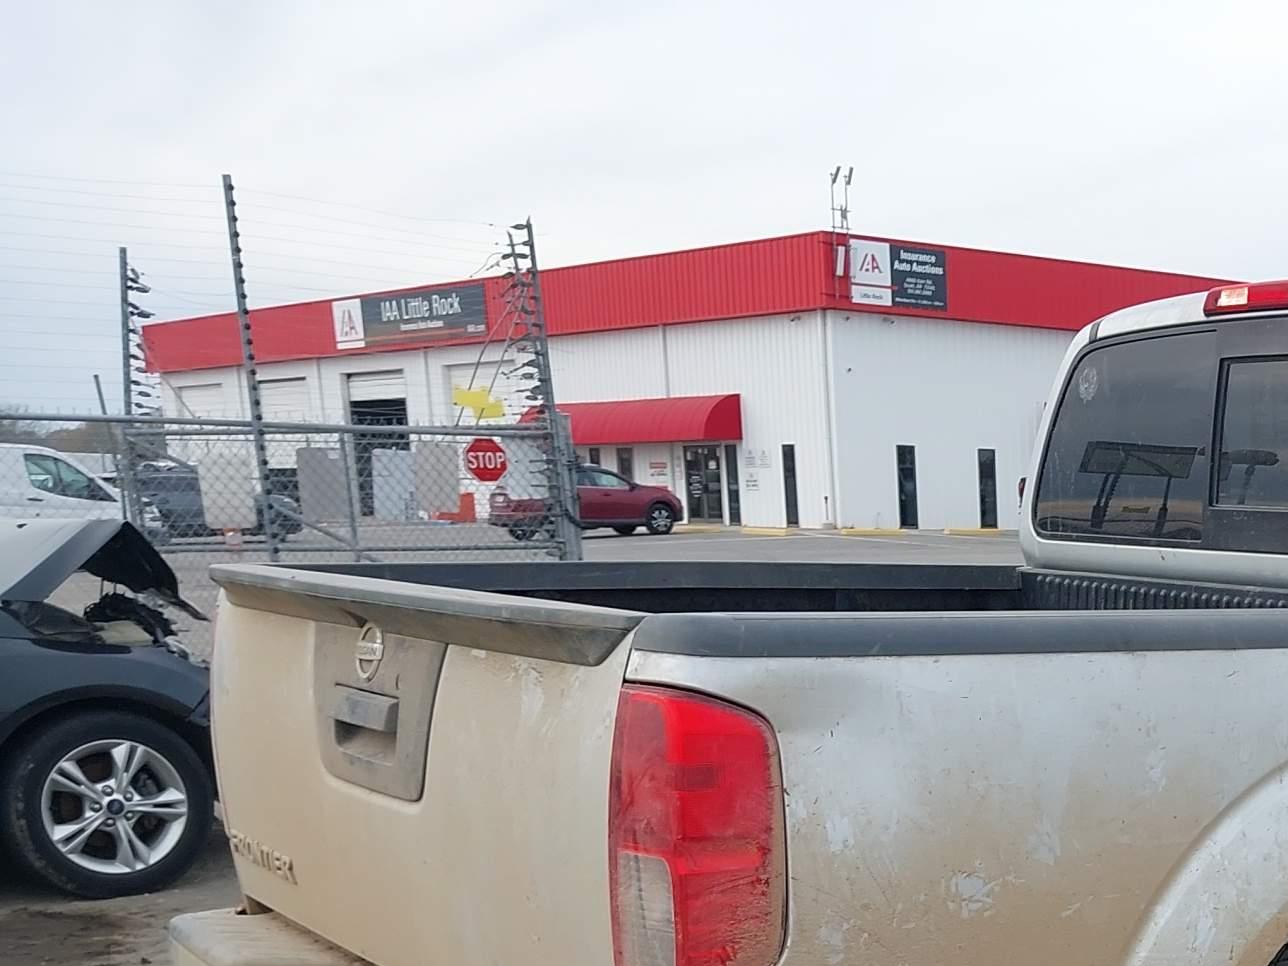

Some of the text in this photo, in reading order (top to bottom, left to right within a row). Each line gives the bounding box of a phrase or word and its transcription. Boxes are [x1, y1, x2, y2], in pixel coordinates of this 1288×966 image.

[900, 250, 936, 263] Insurance
[893, 260, 944, 275] Auto Auctions
[380, 292, 462, 321] IAA Little Rock
[467, 452, 505, 469] STOP
[230, 829, 298, 886] FRONTIER
